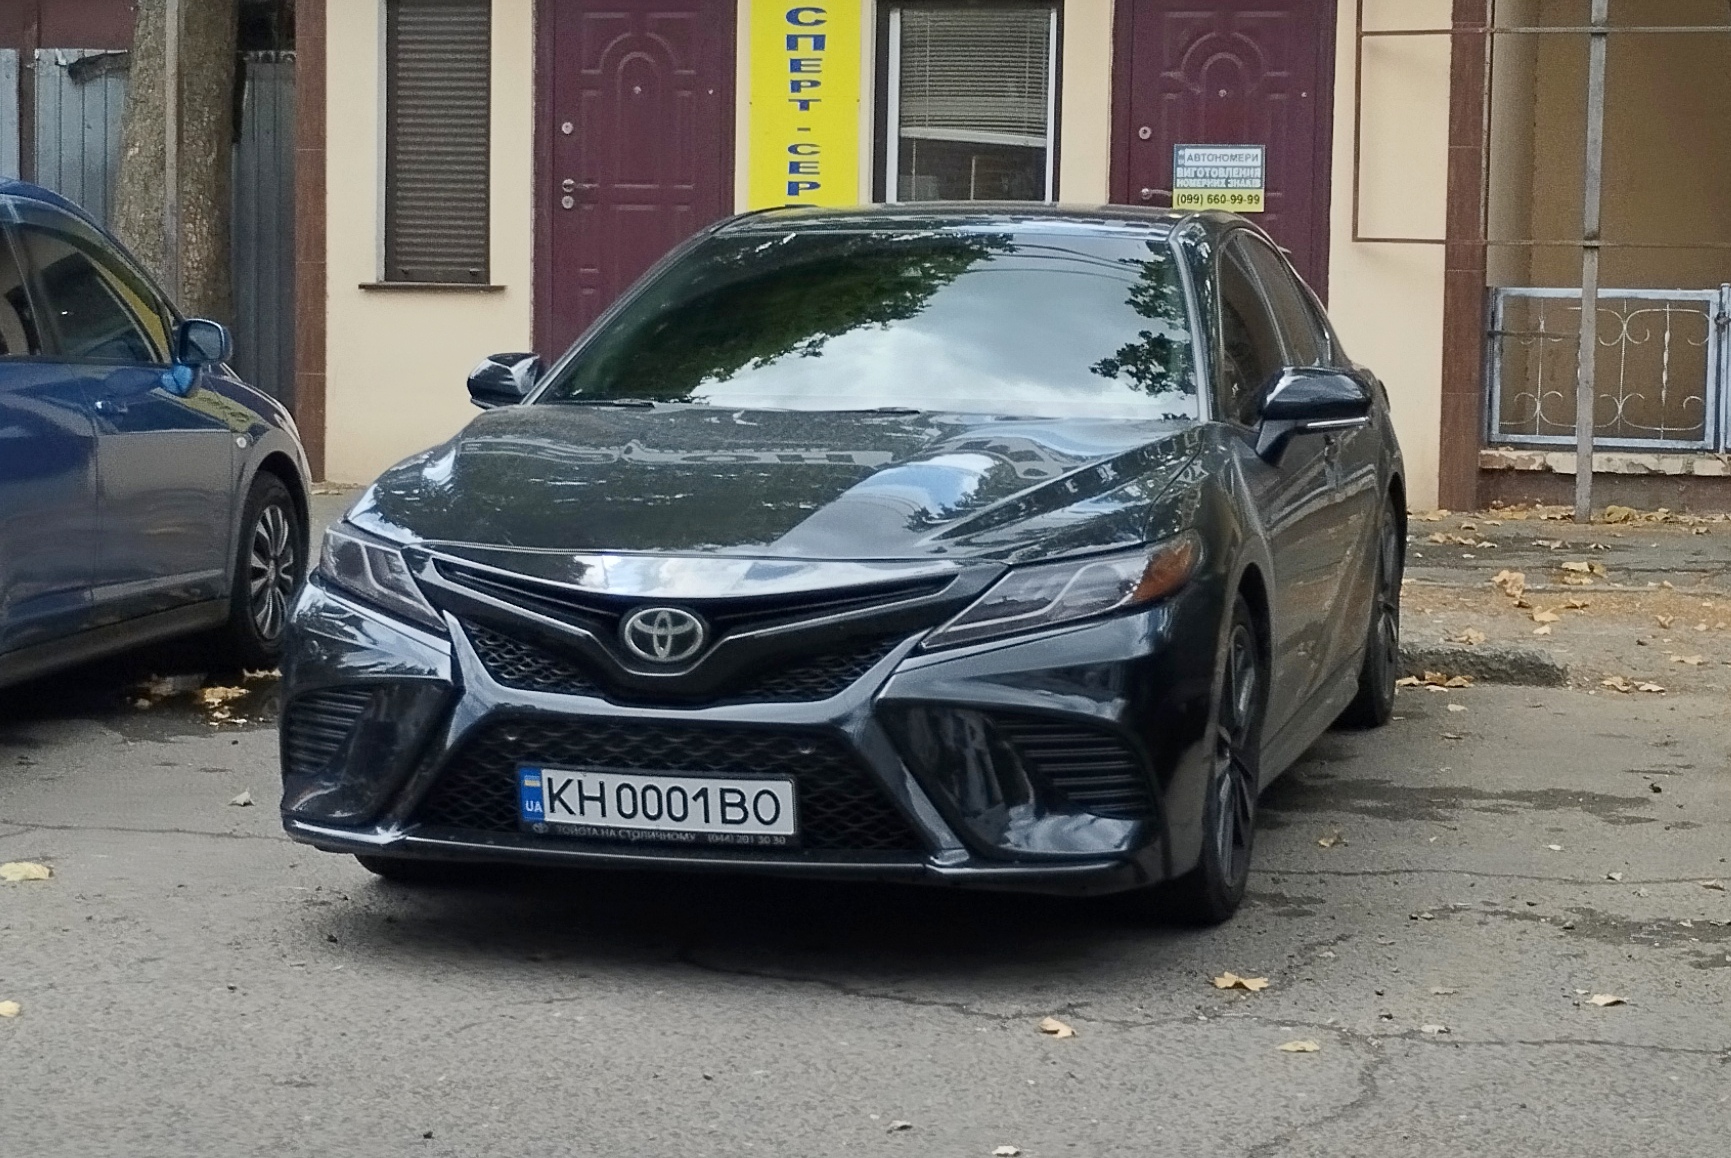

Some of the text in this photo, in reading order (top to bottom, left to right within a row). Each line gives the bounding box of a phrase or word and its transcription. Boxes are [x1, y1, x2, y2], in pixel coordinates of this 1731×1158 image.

[1186, 153, 1259, 163] АВТОНОМЕРИ
[1177, 193, 1260, 206] (099) 660-99-99
[525, 800, 543, 812] UA
